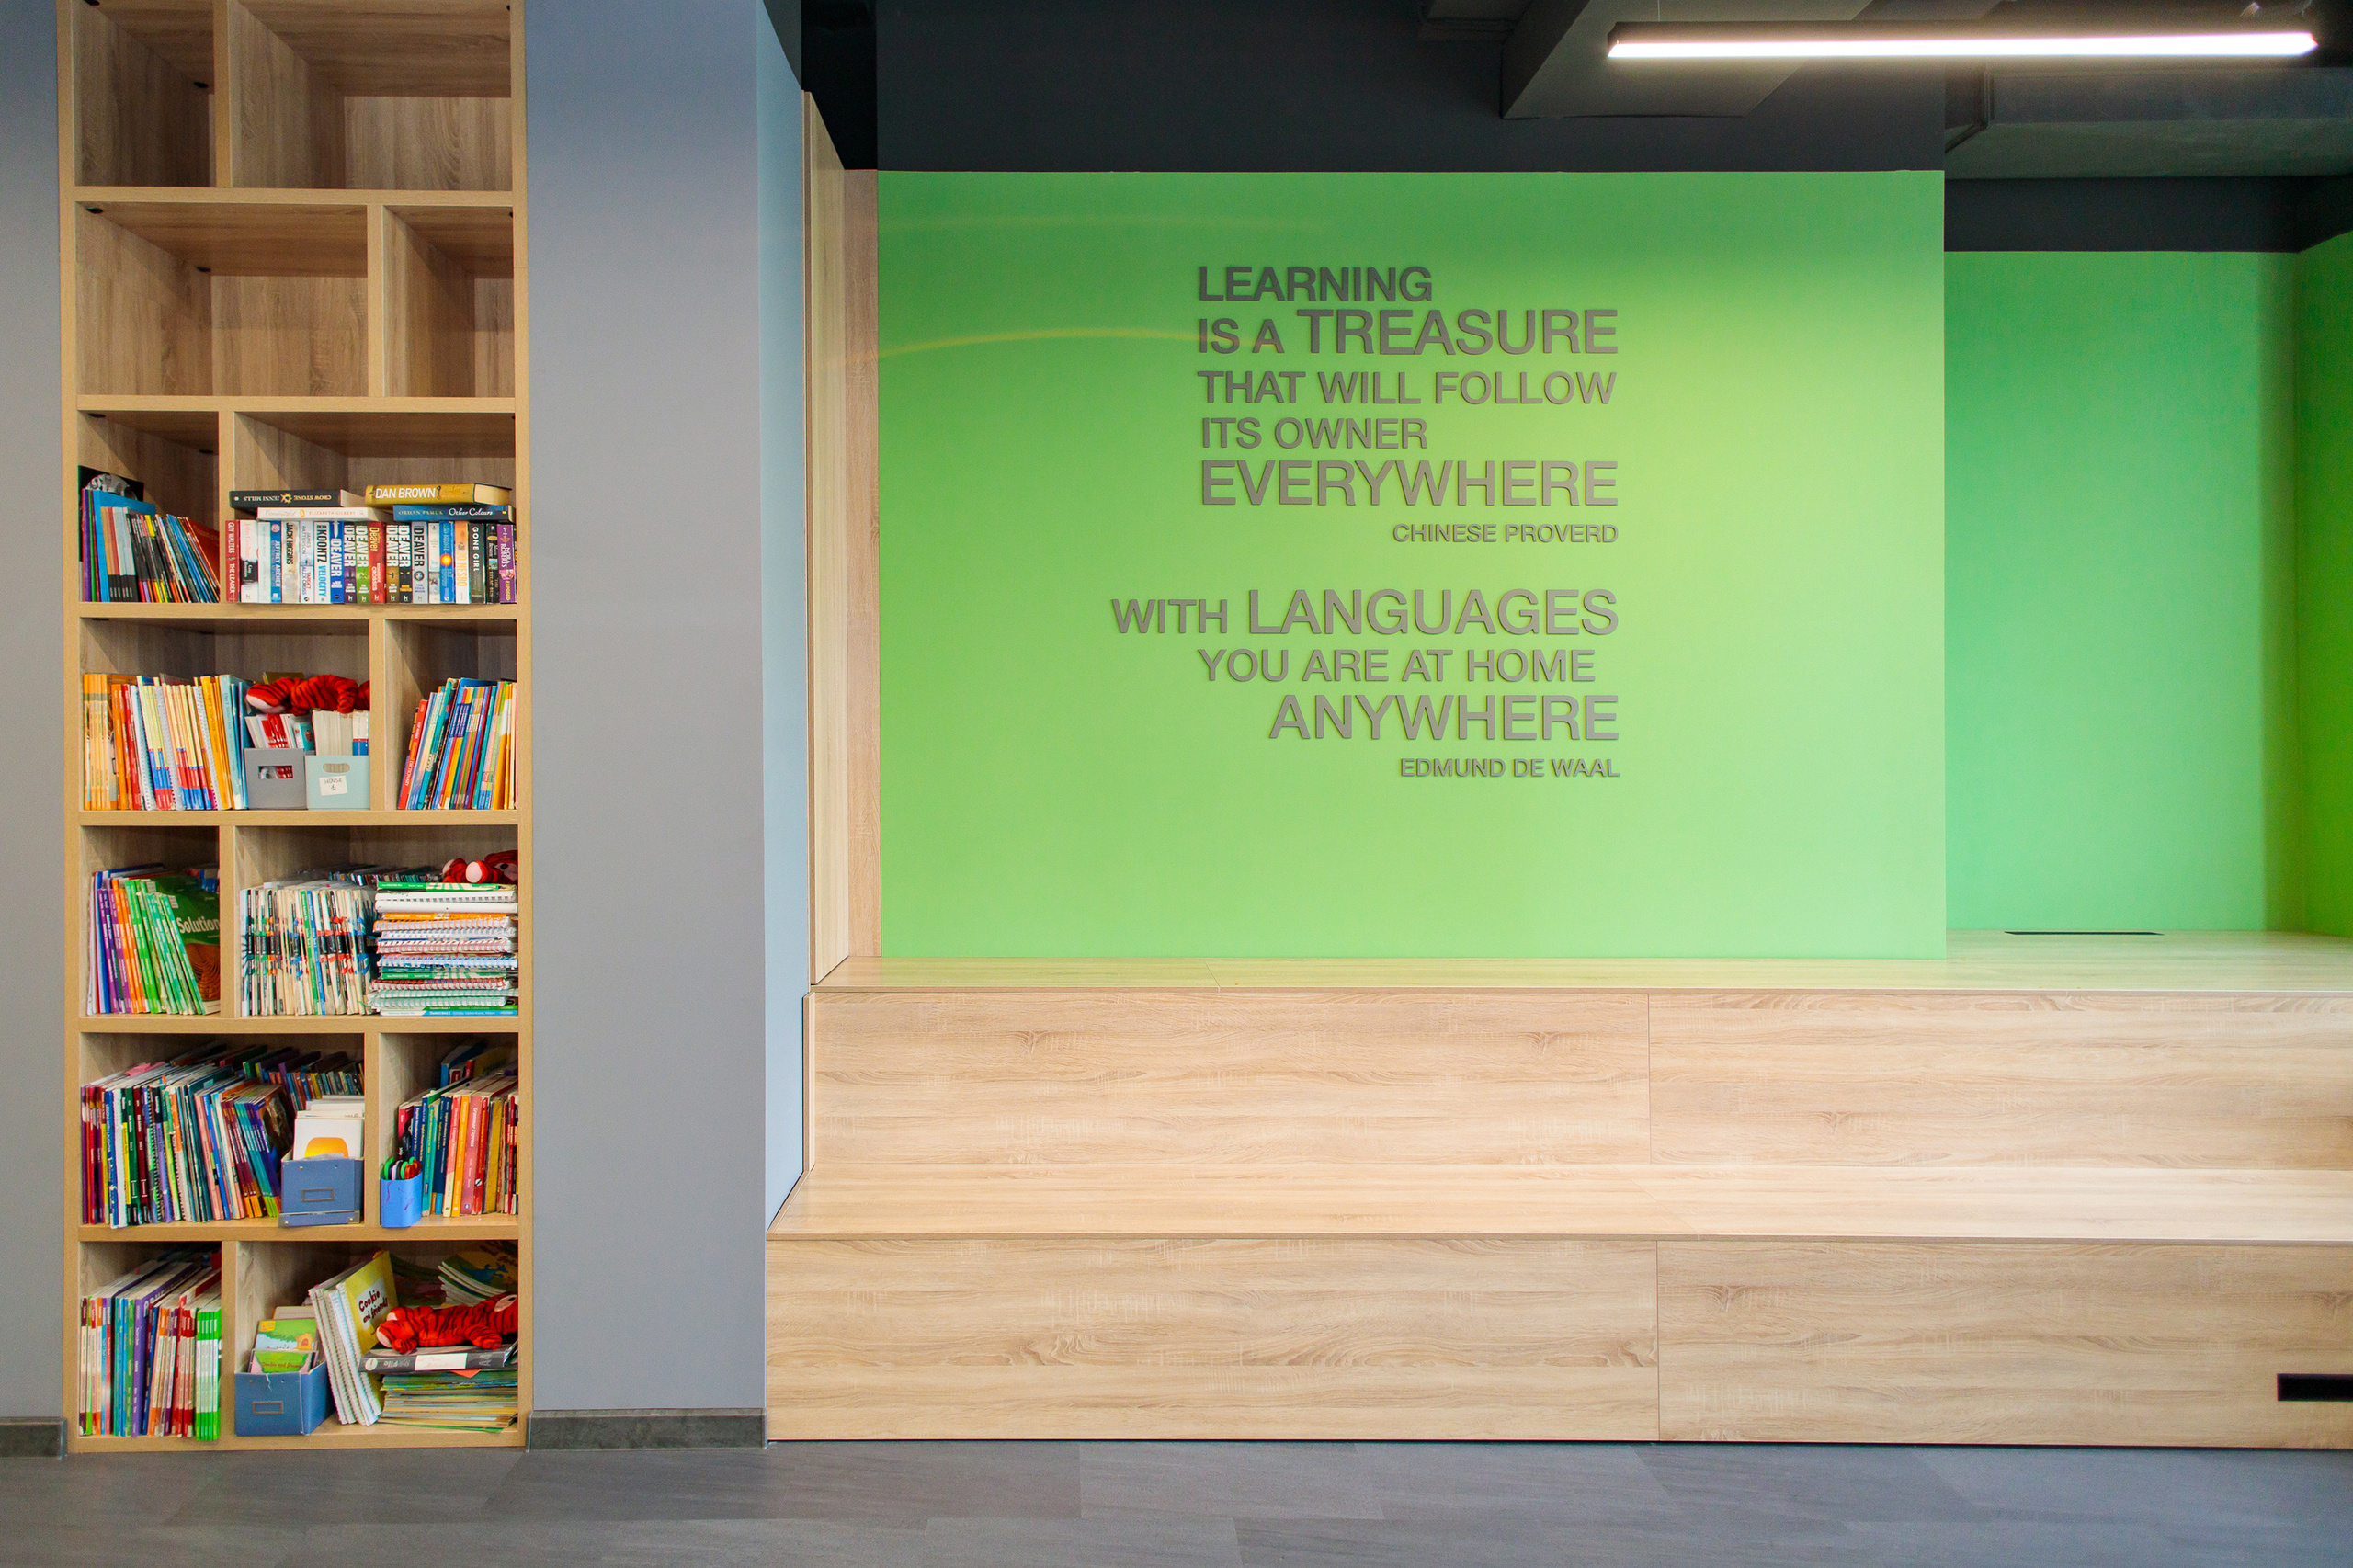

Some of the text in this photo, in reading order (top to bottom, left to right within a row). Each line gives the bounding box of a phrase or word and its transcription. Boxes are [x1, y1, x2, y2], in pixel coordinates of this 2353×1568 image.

[1199, 266, 1433, 304] LEARNING
[1199, 309, 1620, 357] IS A TREASURE
[1198, 370, 1619, 406] THAT WILL FOLLOW
[1202, 417, 1429, 450] ITS OWNER
[375, 487, 436, 499] DAN BROWN
[1202, 460, 1620, 507] EVERYWHERE
[448, 507, 493, 517] Other Colours
[316, 529, 327, 563] KOONTZ
[344, 528, 356, 567] DEAVER
[356, 528, 369, 568] DEAVER
[369, 527, 380, 552] Deaver
[386, 528, 398, 567] DEAVER
[398, 528, 411, 567] DEAVER
[414, 528, 425, 567] DEAVER
[1393, 523, 1620, 544] CHINESE PROVERD
[330, 540, 342, 577] DEAVER
[456, 551, 468, 562] JO
[318, 565, 327, 597] VELOCITY
[1111, 588, 1620, 636] WITH LANGUAGES
[1199, 648, 1597, 683] YOU ARE AT HOME
[1269, 694, 1620, 741] ANYWHERE
[404, 761, 414, 786] DICTIONARY
[1401, 757, 1620, 778] EDMUND DE WAAL
[358, 1290, 381, 1312] Cookie
[363, 1297, 388, 1324] and friends
